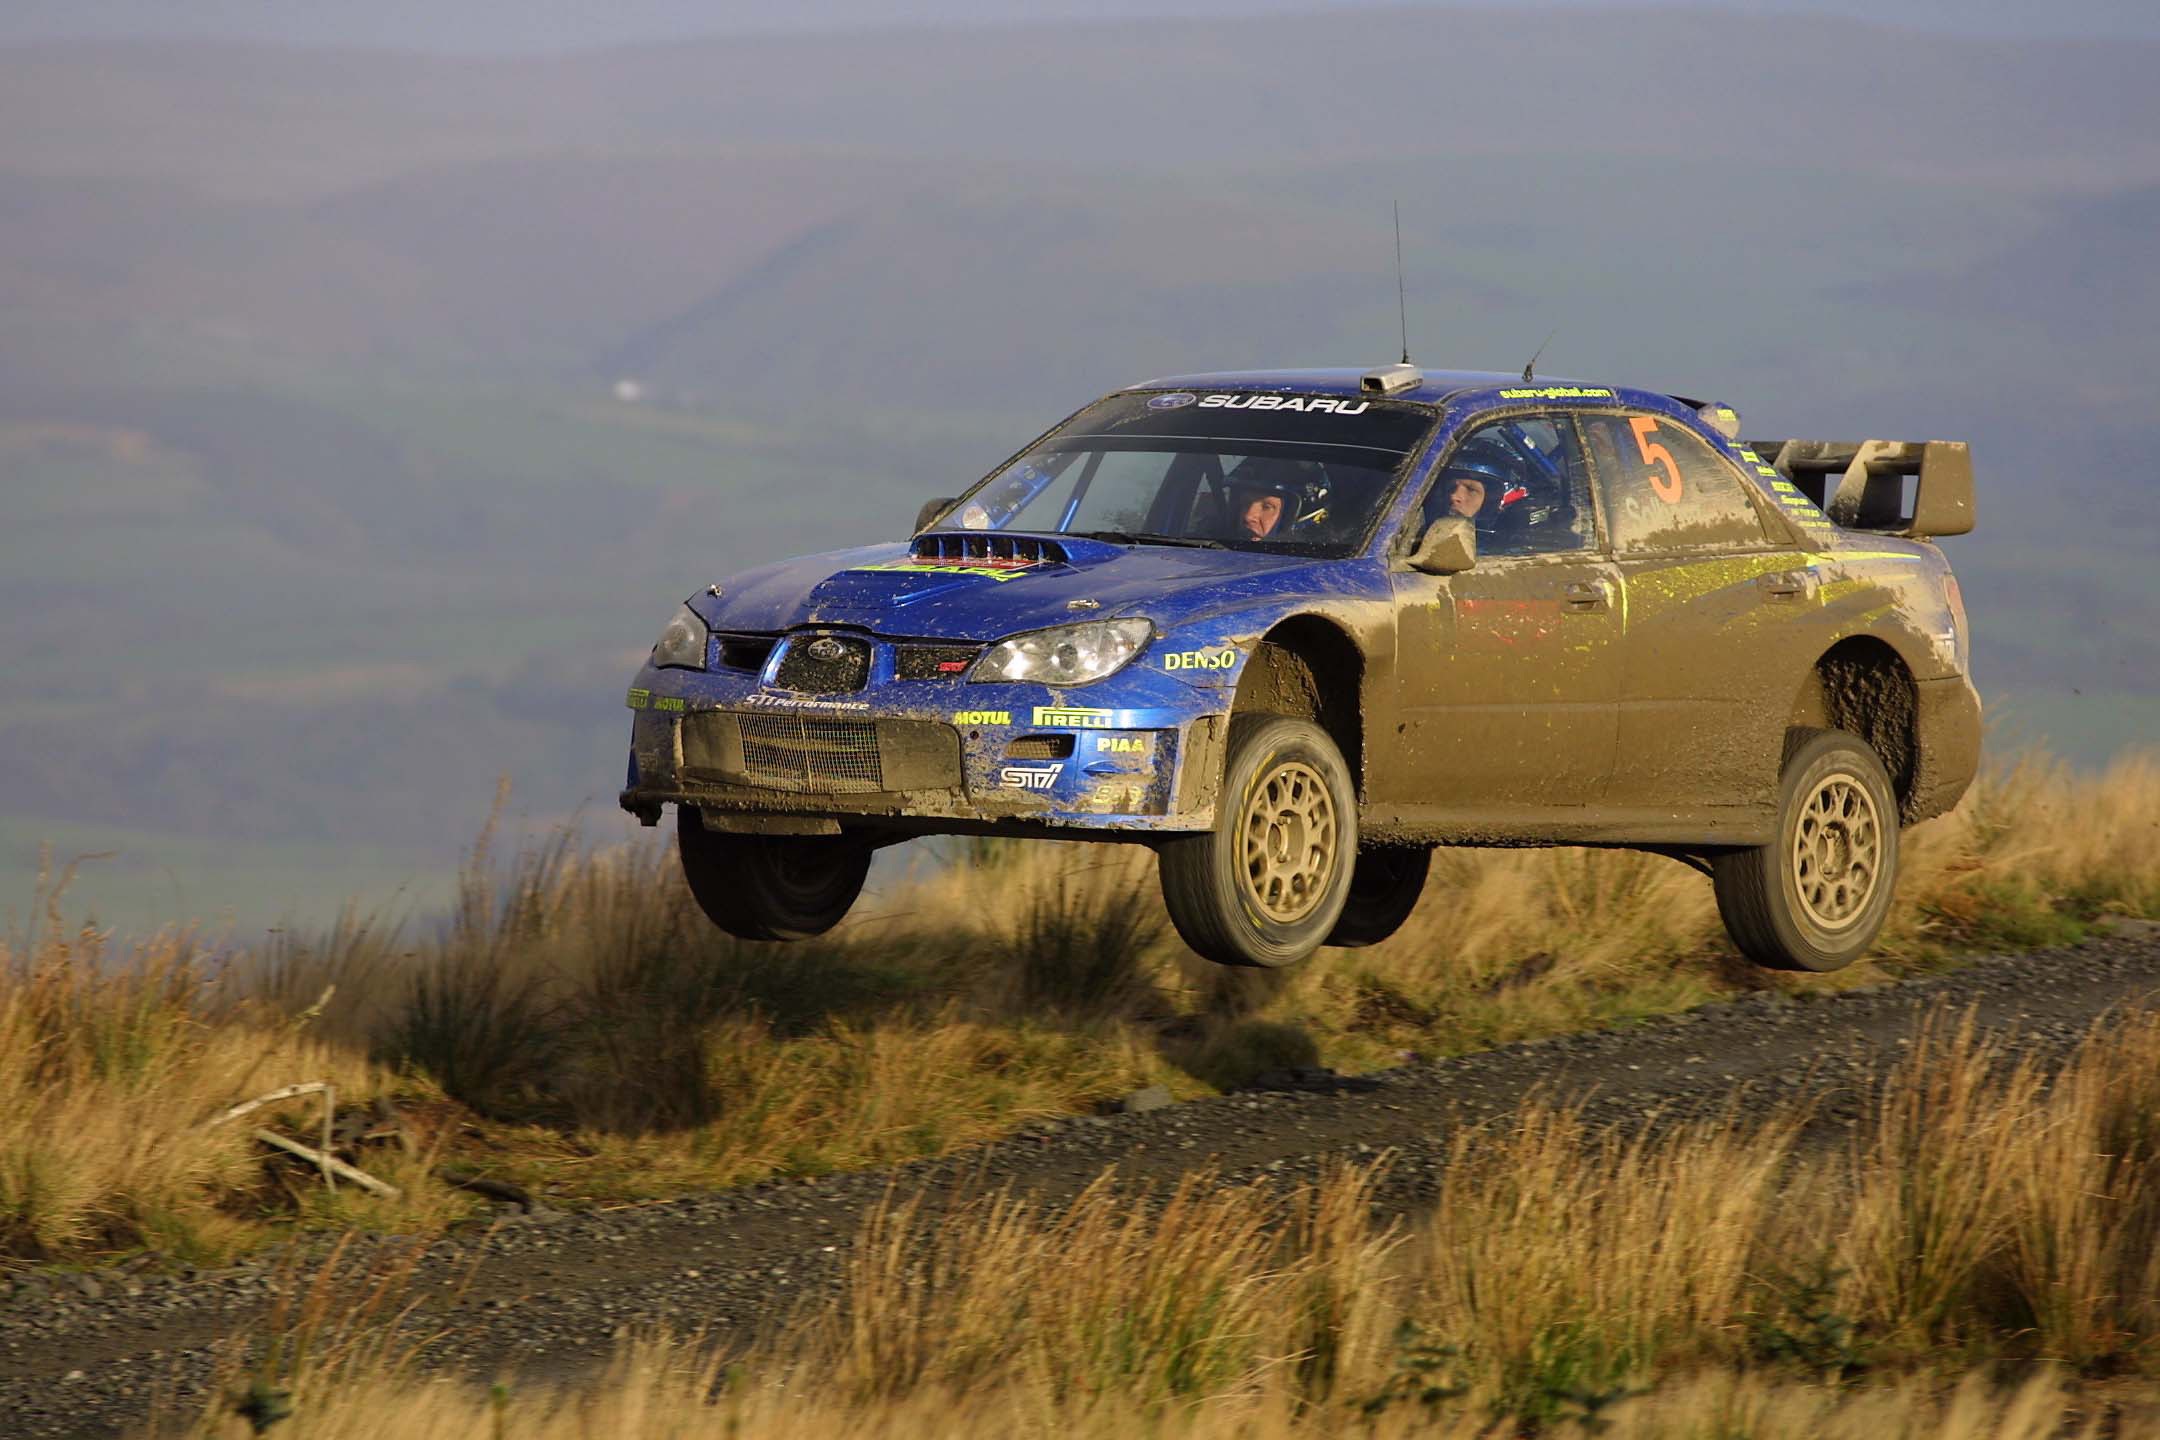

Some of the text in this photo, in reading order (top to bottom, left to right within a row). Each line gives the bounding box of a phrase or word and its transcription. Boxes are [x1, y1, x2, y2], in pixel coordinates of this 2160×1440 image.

[1197, 394, 1369, 416] SUBARU
[1628, 416, 1683, 504] 5
[1164, 650, 1236, 670] DENSO
[953, 711, 1012, 725] MOTUL
[1032, 706, 1113, 728] PIRELLI
[1097, 738, 1145, 752] PIAA
